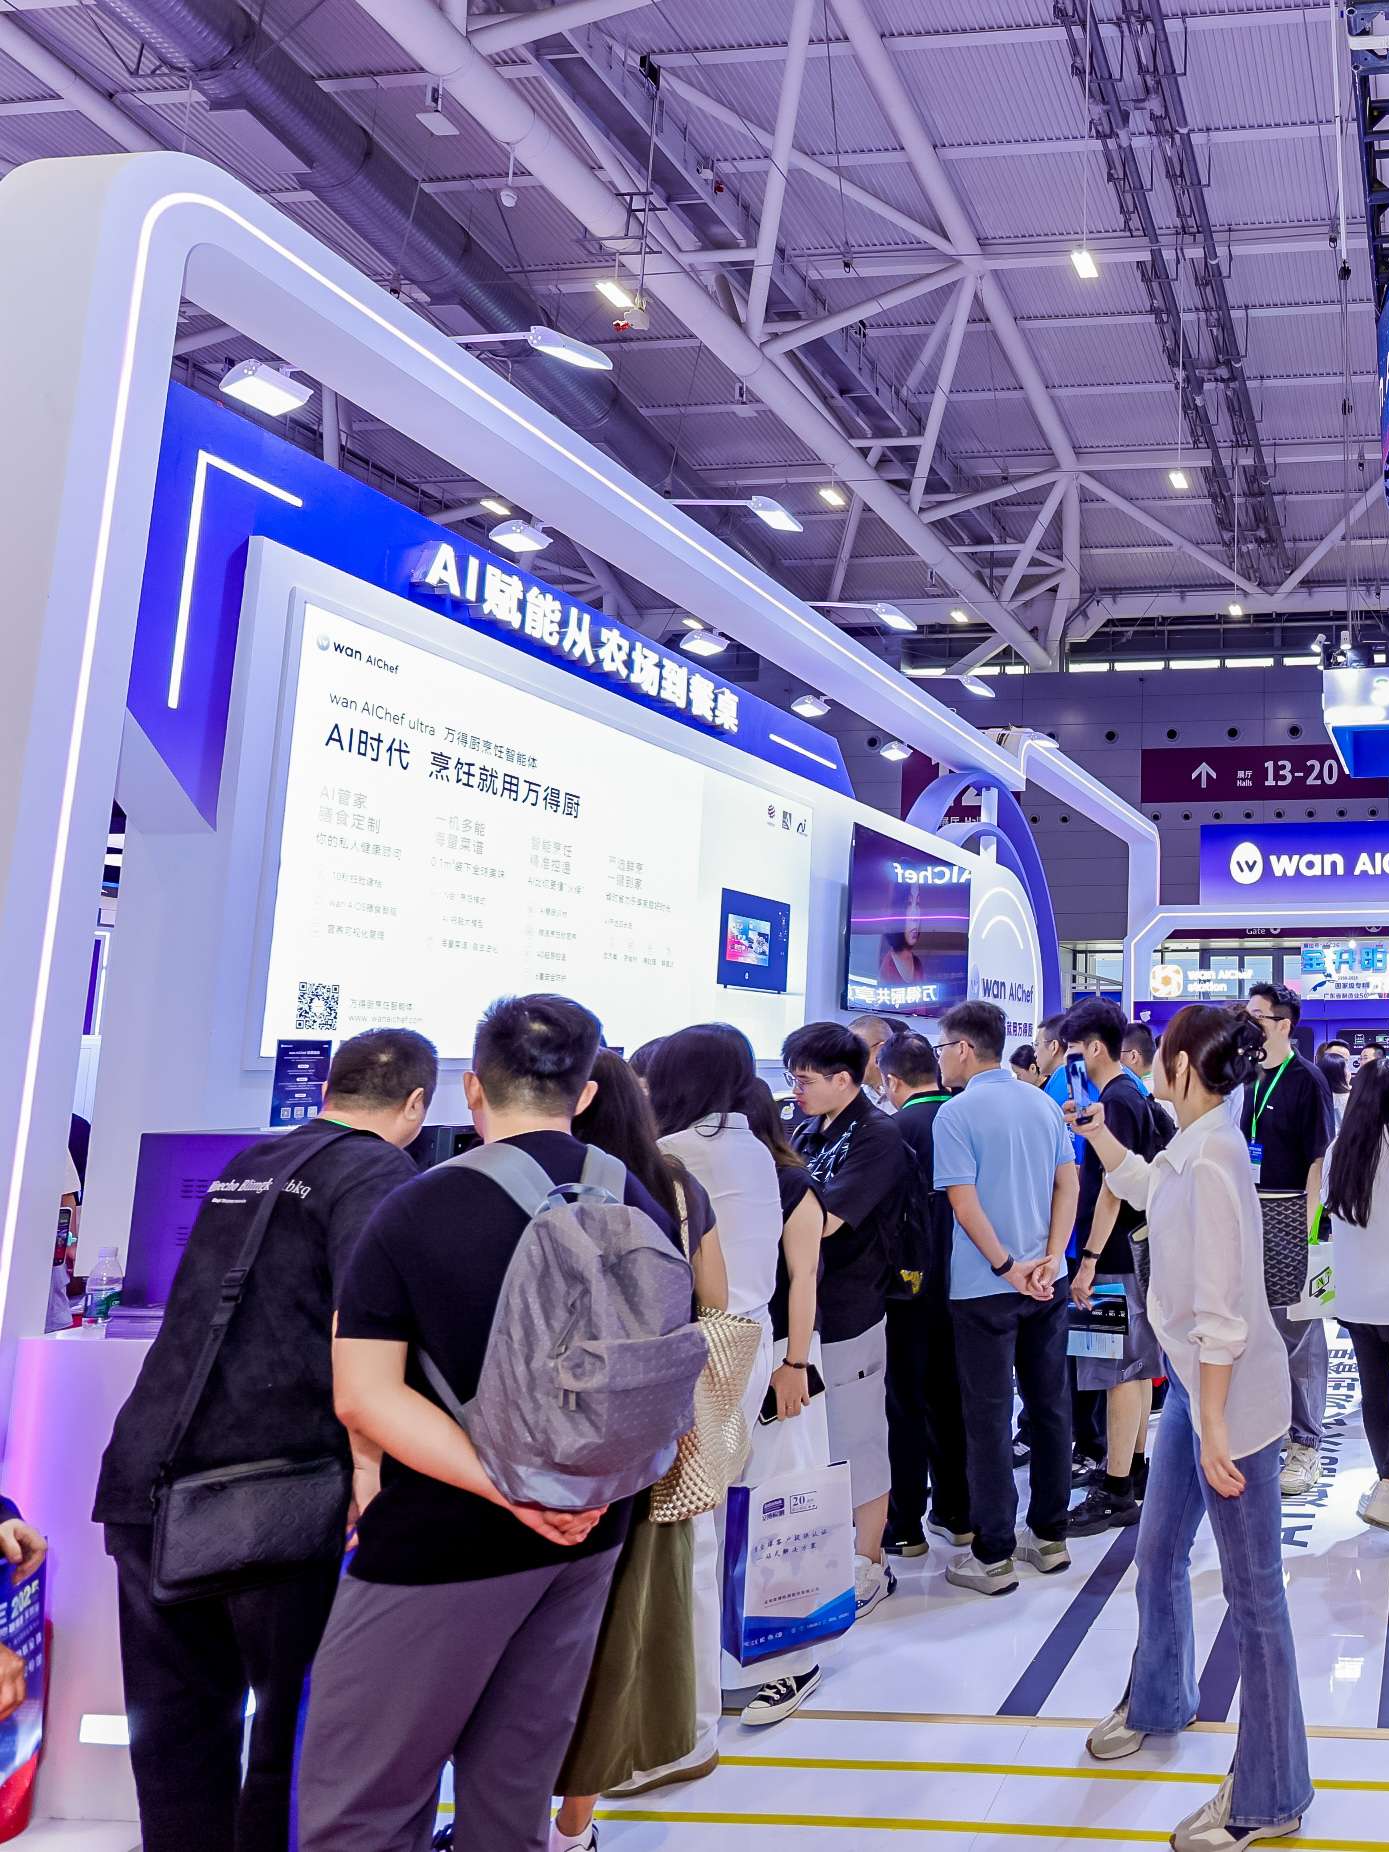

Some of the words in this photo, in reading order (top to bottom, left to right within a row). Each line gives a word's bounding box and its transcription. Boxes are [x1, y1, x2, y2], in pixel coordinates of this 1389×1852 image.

[425, 543, 739, 733] AI赋能从农场到餐桌
[333, 640, 362, 661] wan
[366, 655, 400, 674] AIChef
[329, 692, 358, 711] wan
[361, 701, 406, 726] AIChef
[408, 718, 436, 736] ultra
[443, 727, 538, 769] 万得厨烹饪智能体
[325, 722, 411, 771] AI时代
[428, 750, 581, 819] 烹饪就用万得厨
[1236, 770, 1253, 779] 展厅
[1236, 779, 1253, 787] Halls
[1263, 759, 1339, 786] 13-20
[1269, 853, 1344, 877] wan
[982, 976, 1007, 1000] wan
[1009, 984, 1034, 1004] AIChef
[793, 1495, 806, 1507] 20
